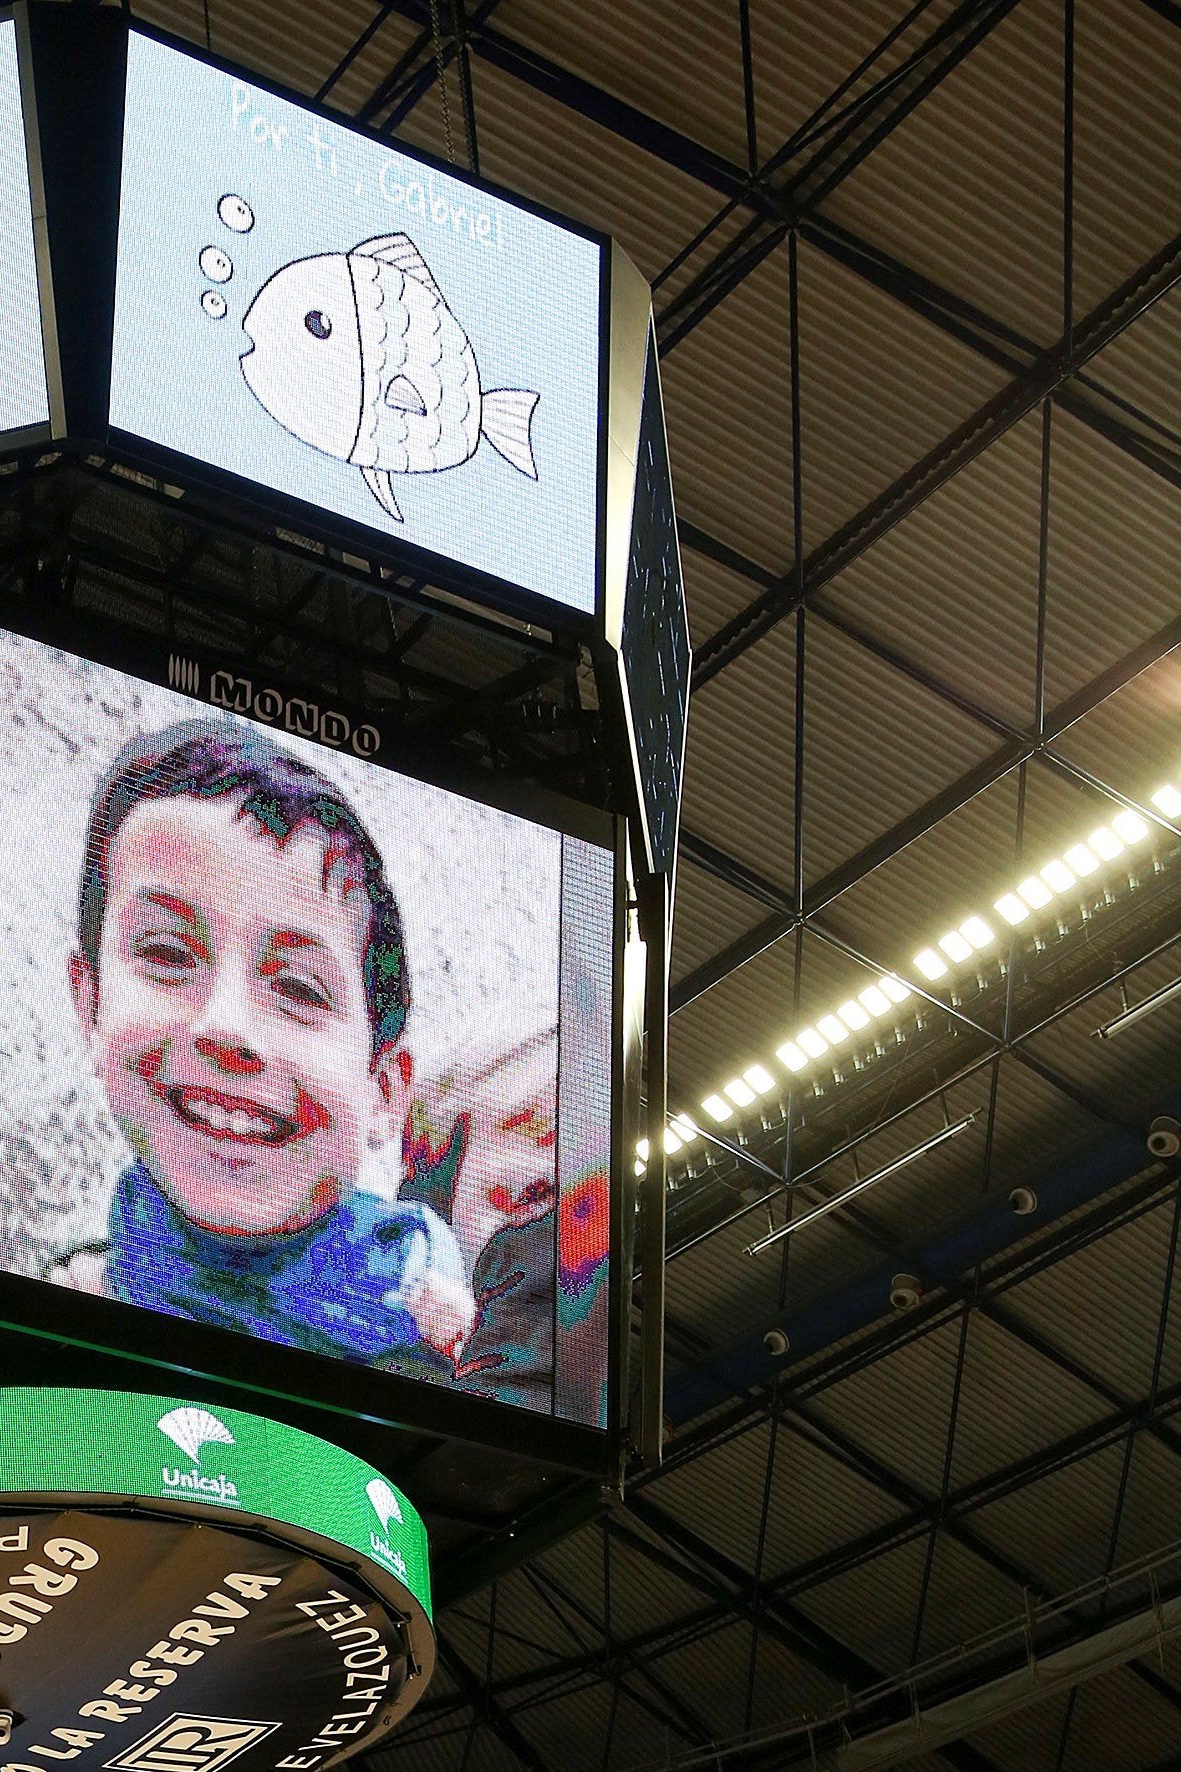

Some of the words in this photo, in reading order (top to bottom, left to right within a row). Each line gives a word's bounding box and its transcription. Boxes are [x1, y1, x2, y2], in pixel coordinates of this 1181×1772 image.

[231, 81, 289, 152] Por
[380, 160, 503, 253] Gabriel
[210, 670, 381, 757] MONDO
[162, 1466, 239, 1501] Unicaja
[27, 1727, 107, 1760] LA
[78, 1571, 283, 1724] RESERVA
[294, 1590, 392, 1758] VELAZQUEZ
